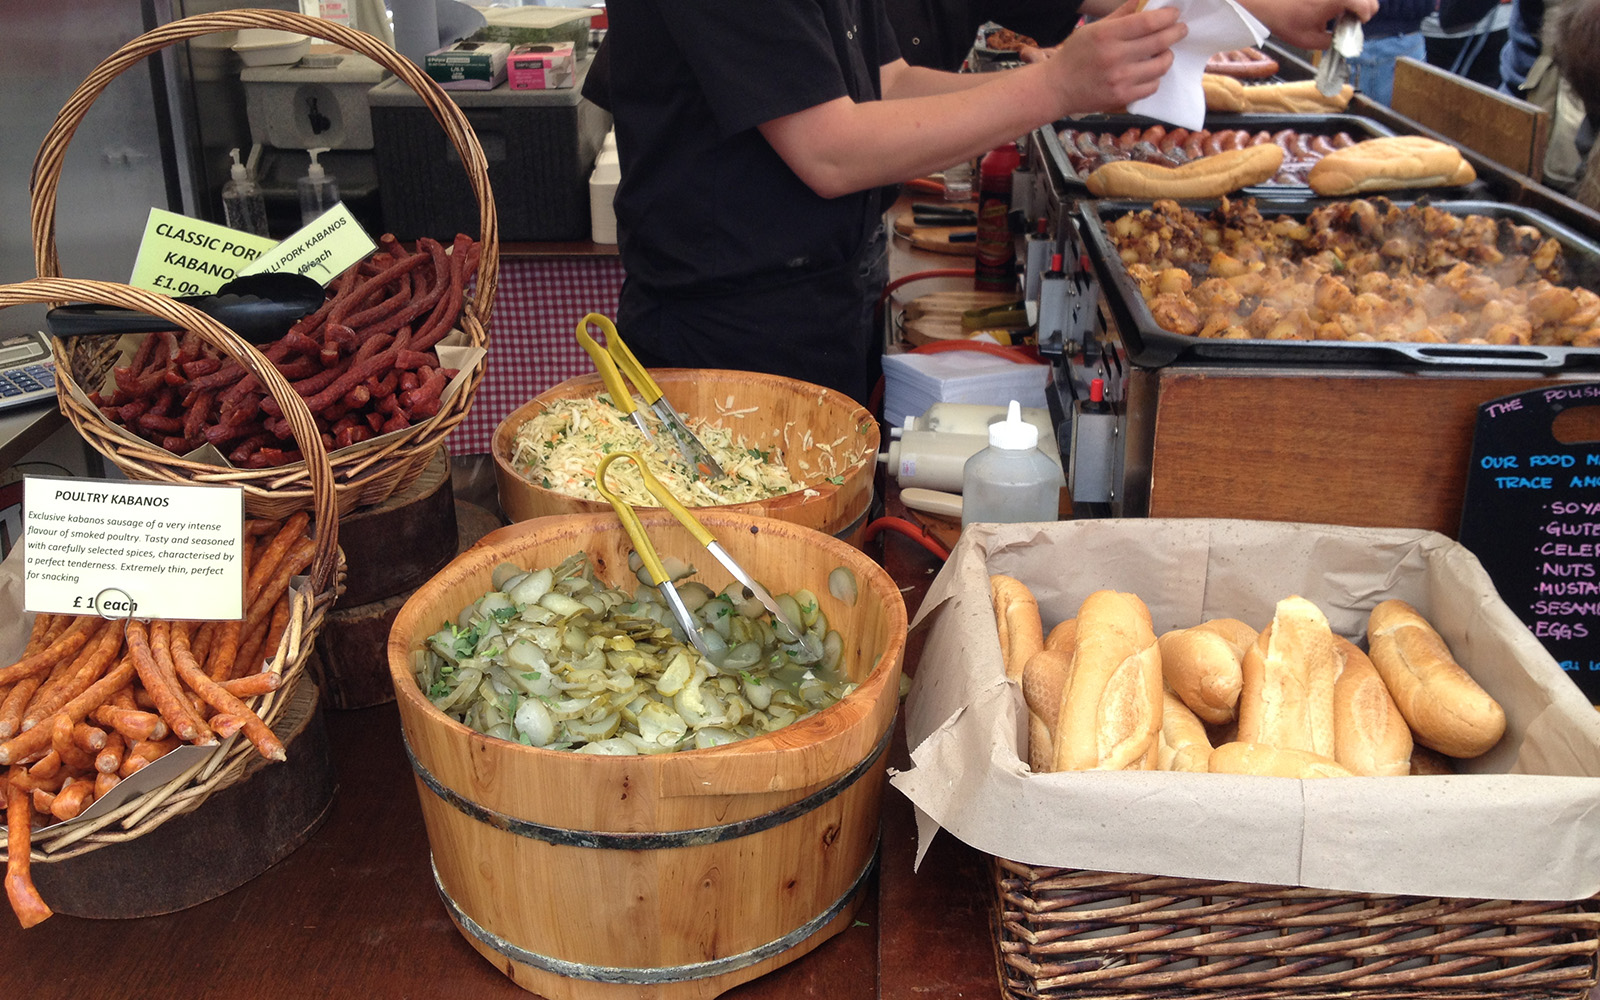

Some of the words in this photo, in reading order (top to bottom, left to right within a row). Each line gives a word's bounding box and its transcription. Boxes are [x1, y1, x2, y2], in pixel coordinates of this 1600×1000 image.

[156, 223, 220, 250] CLASSIC
[280, 245, 306, 266] PORK
[305, 217, 347, 248] KABANOS
[164, 252, 238, 280] KABANO
[1485, 398, 1523, 418] THE
[1480, 455, 1519, 469] OUR
[1529, 455, 1576, 468] FOOD
[1495, 476, 1552, 489] TRACE
[55, 491, 108, 503] POULTRY
[111, 495, 169, 507] KABANOS
[29, 511, 65, 521] Exclusive
[68, 514, 104, 524] kabanos
[107, 519, 143, 528] sausage
[146, 520, 156, 529] of
[27, 526, 57, 535] flavour
[60, 529, 69, 538] of
[71, 531, 105, 539] smoked
[107, 534, 140, 543] poultry.
[146, 535, 169, 544] Tasty
[48, 544, 85, 554] carefully
[88, 546, 124, 555] selected
[127, 550, 155, 558] spices,
[158, 550, 221, 560] characterised
[223, 553, 234, 562] by
[35, 558, 65, 567] perfect
[68, 560, 117, 570] tenderness.
[121, 563, 165, 574] Extremely
[168, 565, 188, 574] thin,
[191, 566, 223, 576] perfect
[1543, 562, 1596, 577] NUTS
[27, 570, 39, 579] for
[42, 574, 79, 584] snacking
[1540, 582, 1600, 595] MUSTA
[73, 596, 82, 608] £
[86, 597, 94, 608] 1
[104, 599, 138, 611] each
[1536, 621, 1589, 640] EGGS
